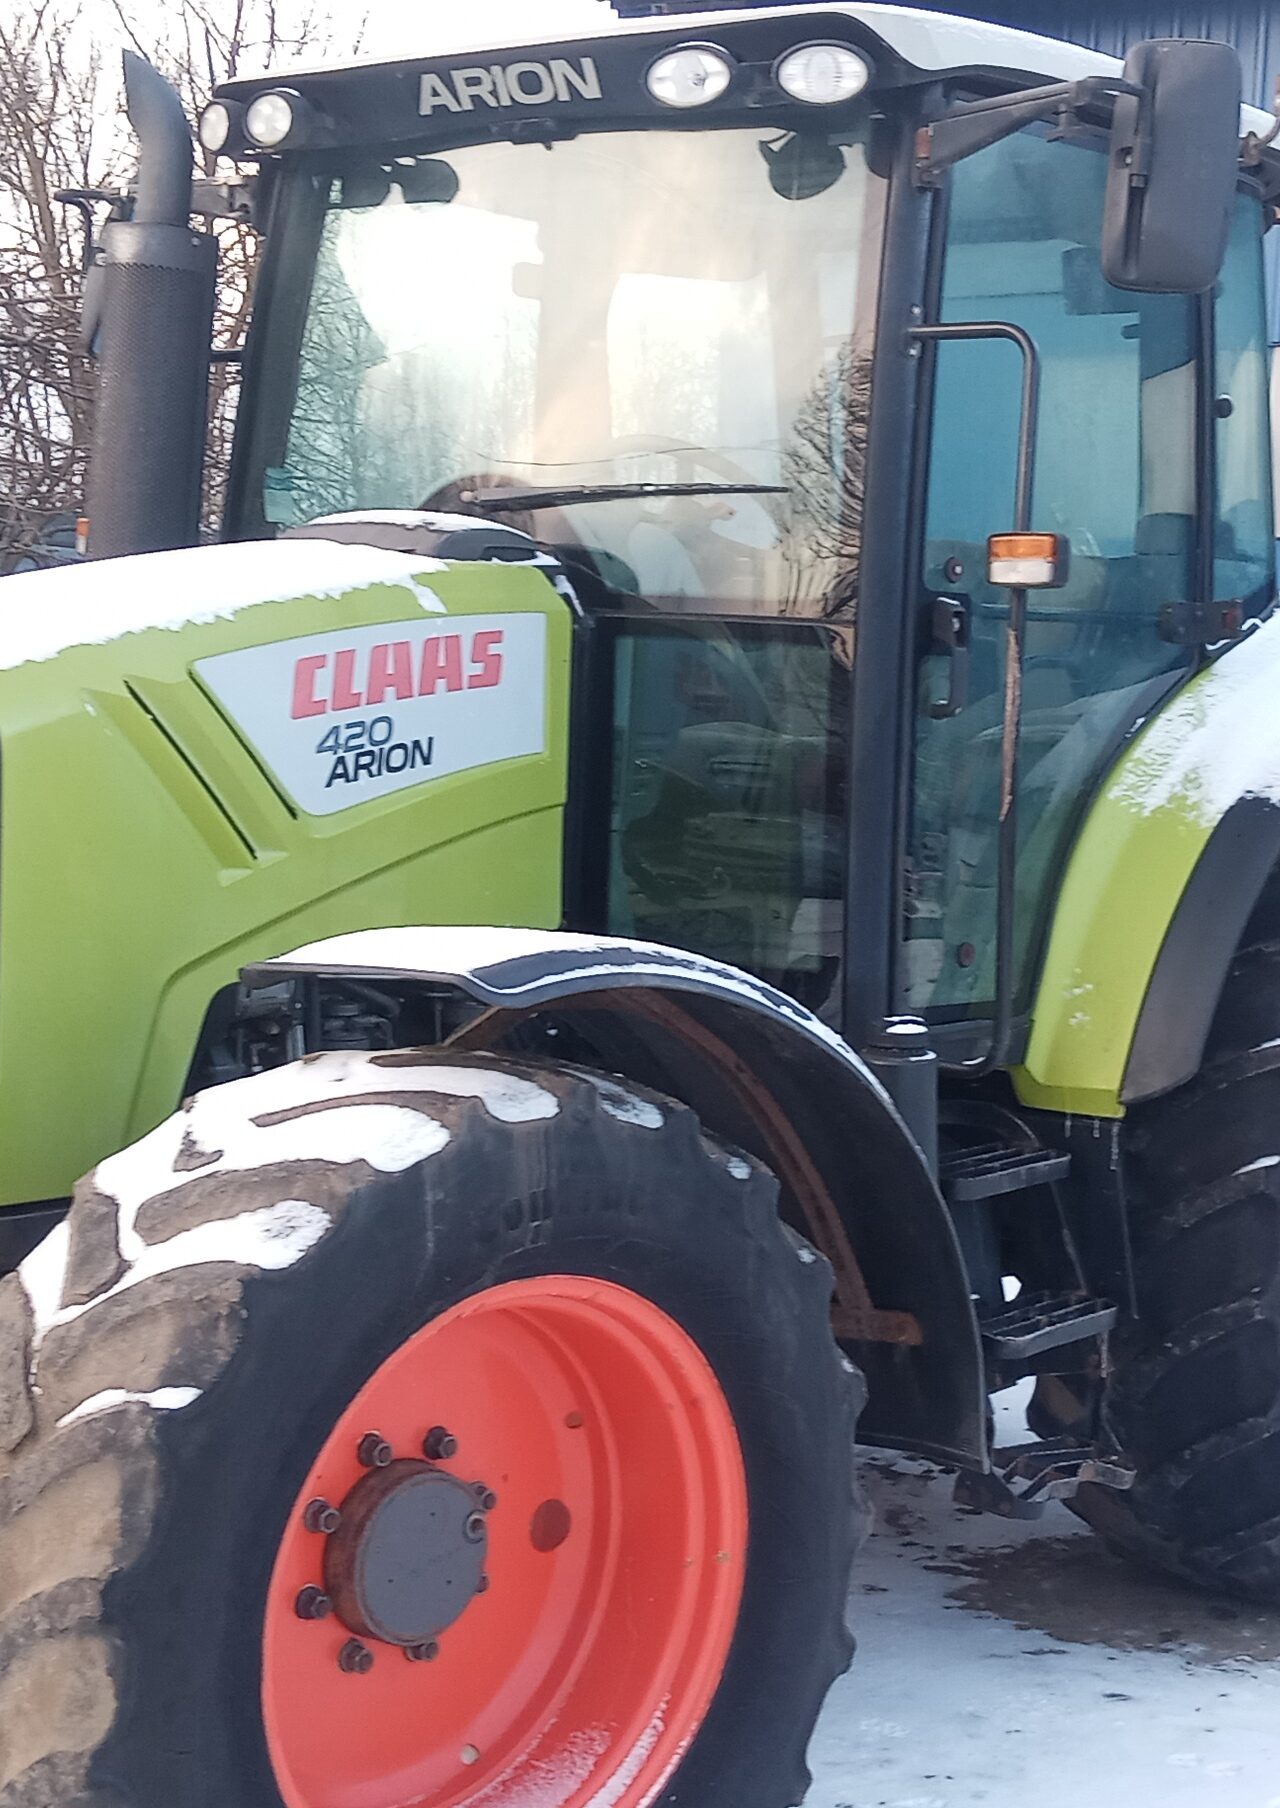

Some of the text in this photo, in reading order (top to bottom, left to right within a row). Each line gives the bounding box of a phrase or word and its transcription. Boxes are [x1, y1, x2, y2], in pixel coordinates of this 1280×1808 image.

[418, 57, 603, 115] ARION
[290, 630, 504, 720] CLAAS
[315, 715, 394, 756] 420
[324, 736, 434, 788] ARION
